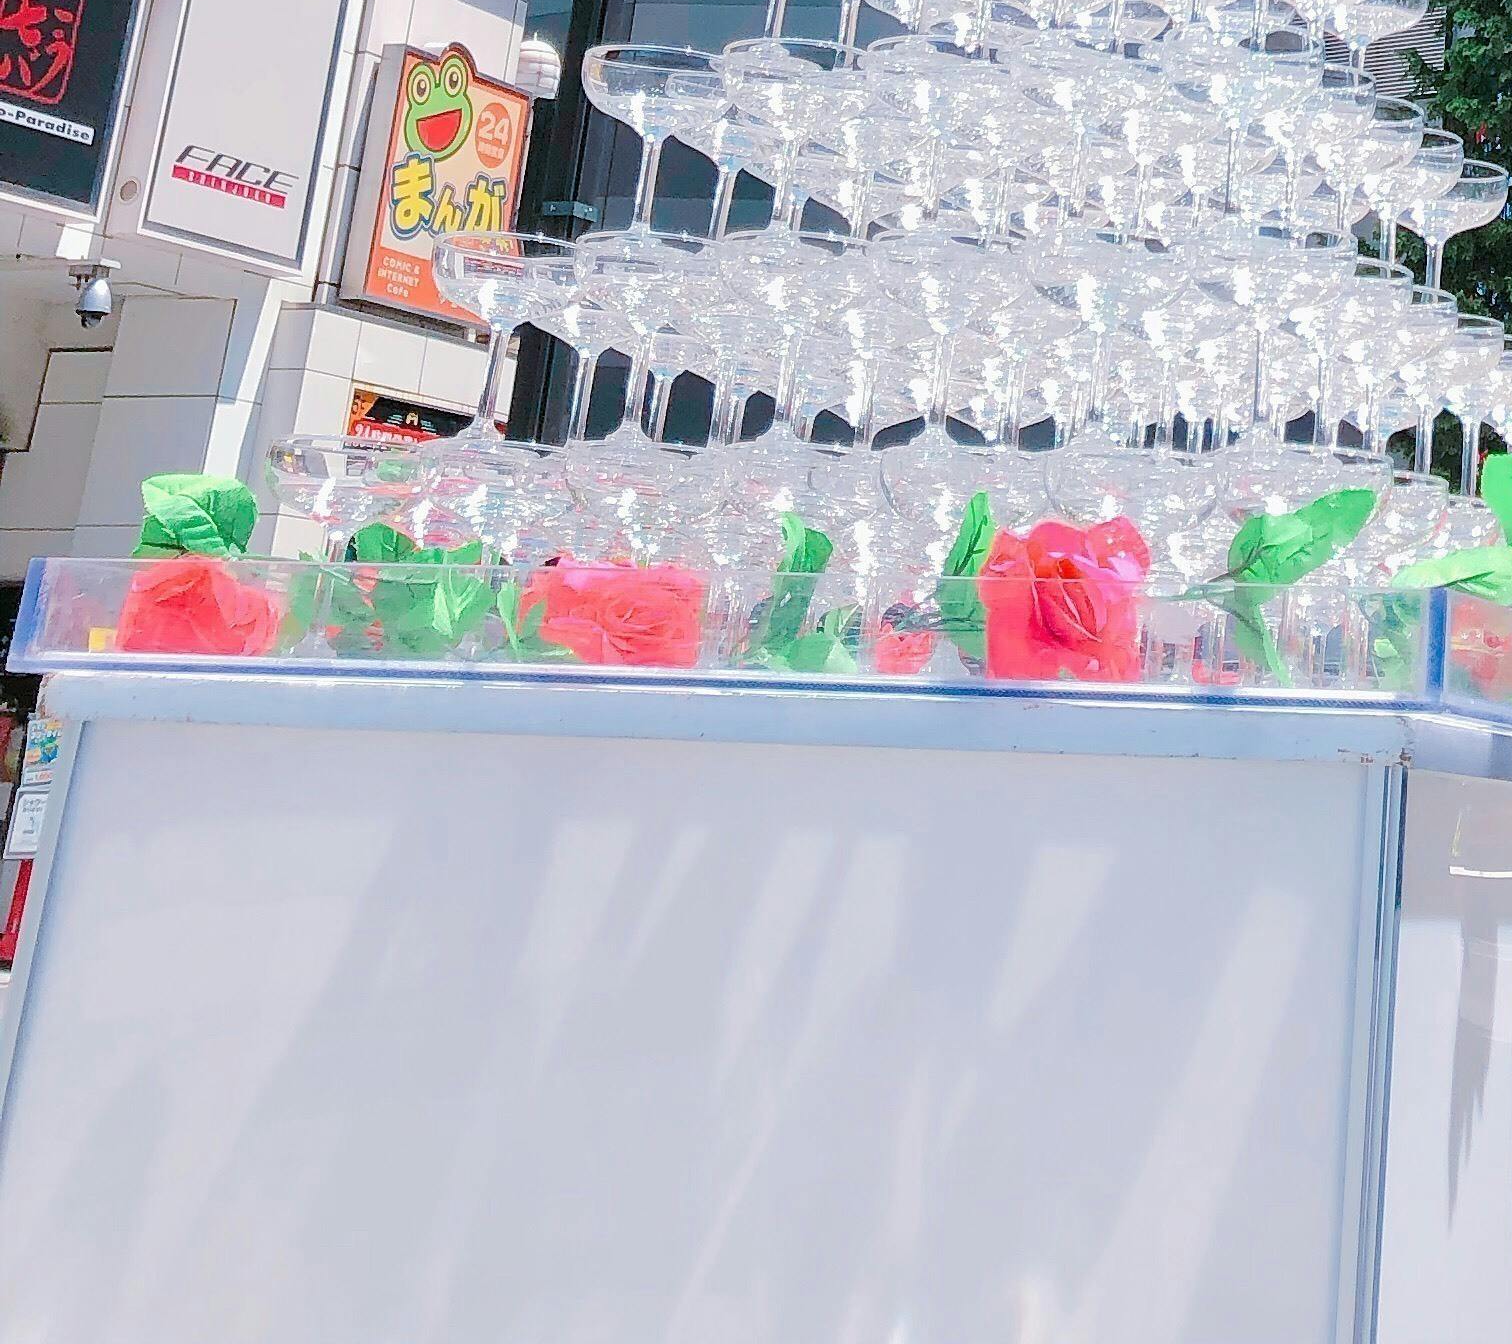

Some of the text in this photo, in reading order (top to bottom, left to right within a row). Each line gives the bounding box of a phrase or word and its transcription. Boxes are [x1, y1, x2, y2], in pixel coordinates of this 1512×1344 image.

[478, 110, 510, 145] 24
[175, 144, 300, 195] FACE
[391, 155, 506, 238] まんが
[382, 255, 412, 273] COMIC
